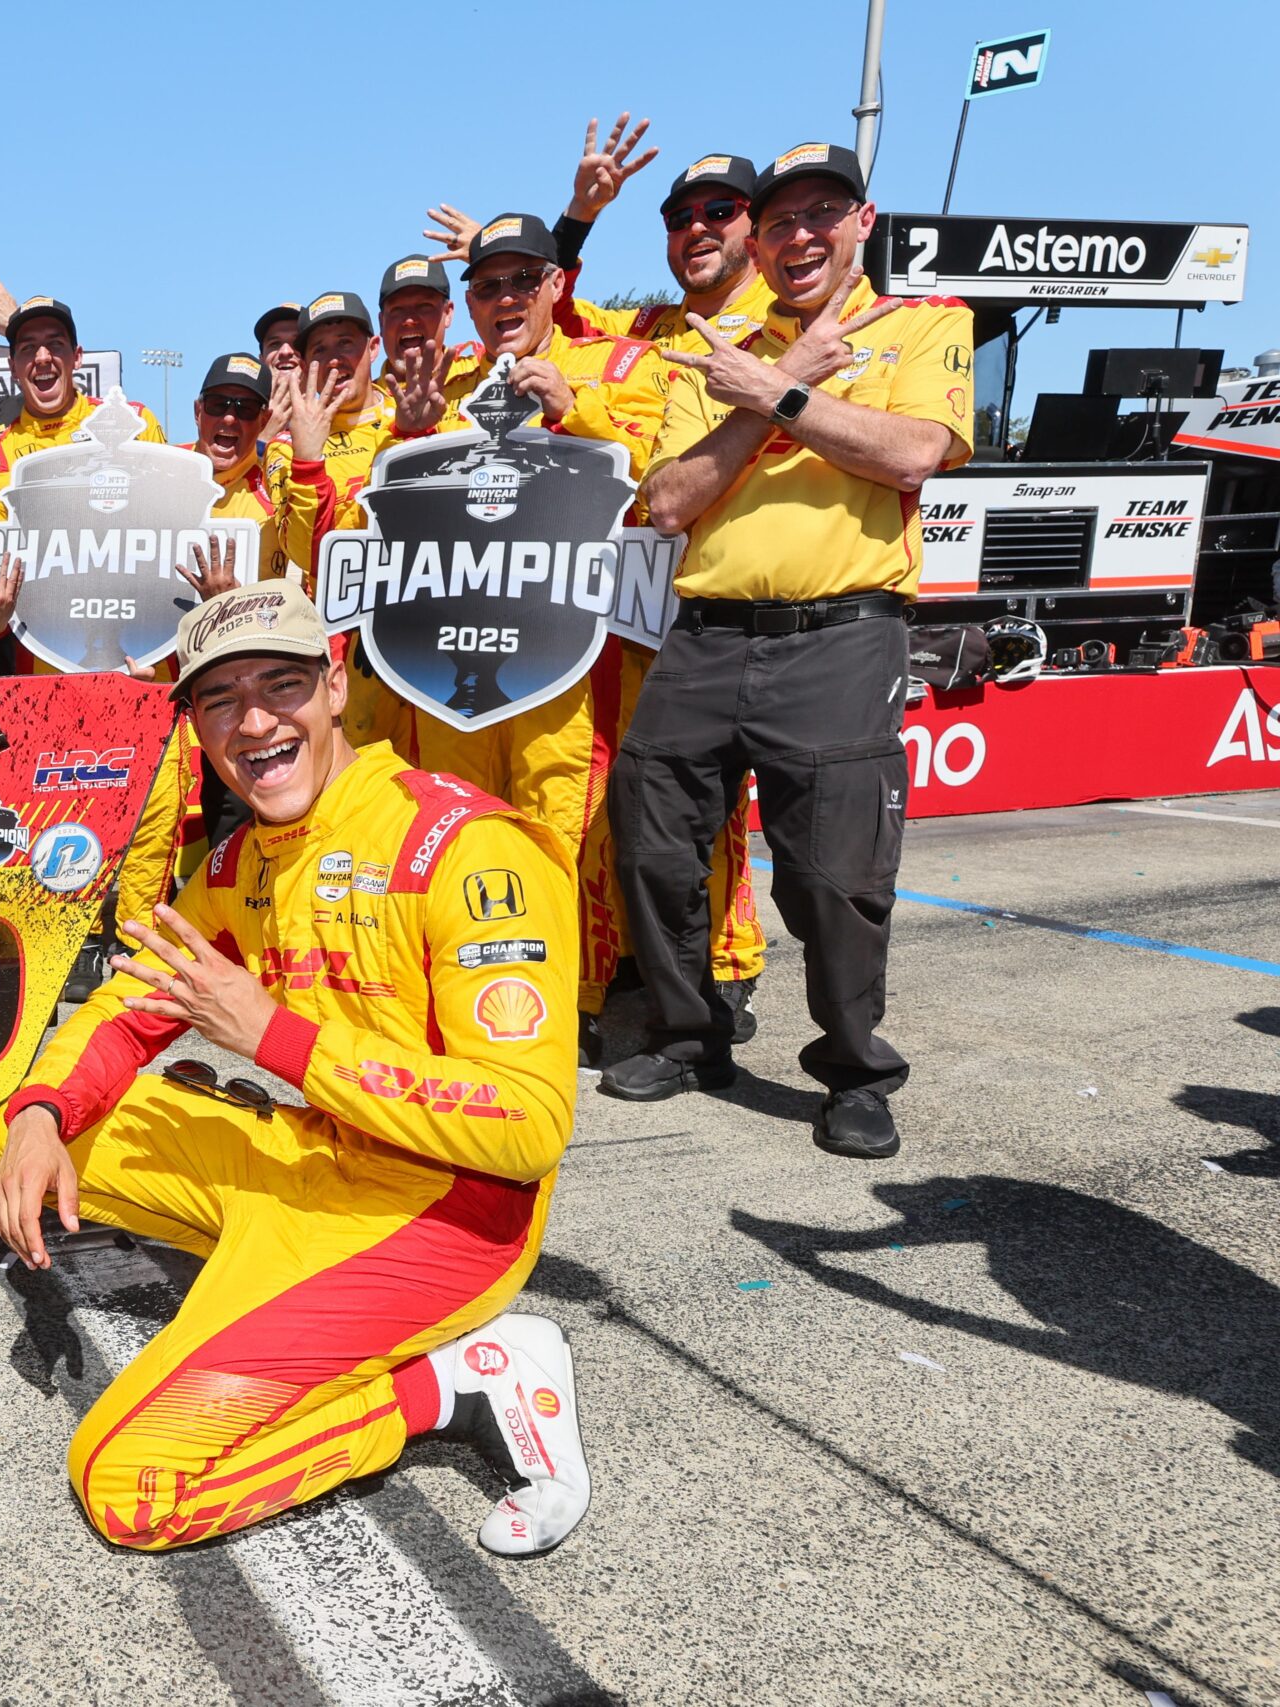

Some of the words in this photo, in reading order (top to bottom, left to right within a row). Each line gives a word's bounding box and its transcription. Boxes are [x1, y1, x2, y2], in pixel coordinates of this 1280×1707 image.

[974, 54, 986, 82] TEAM
[979, 50, 994, 88] PENSKE
[990, 43, 1045, 81] 2
[907, 227, 939, 287] 2
[978, 224, 1147, 274] Astemo
[1186, 272, 1237, 281] CHEVROLET
[1028, 284, 1110, 297] NEWGARDEN
[1241, 379, 1280, 403] TE
[1207, 402, 1280, 431] PEN
[322, 446, 370, 459] HONDA
[108, 475, 128, 485] NTT
[491, 474, 516, 484] NTT
[89, 487, 129, 496] INDYCAR
[467, 488, 518, 499] INDYCAR
[1012, 484, 1077, 500] Snap-on
[920, 503, 969, 521] EAM
[1126, 500, 1189, 516] TEAM
[923, 526, 973, 542] SKE
[1104, 521, 1192, 539] PENSKE
[324, 538, 675, 639] CHAMPION
[69, 598, 136, 620] 2025
[217, 614, 254, 638] 2025
[437, 626, 520, 653] 2025
[33, 746, 136, 786] HRC
[79, 779, 128, 789] RACING
[409, 805, 472, 878] sparco
[336, 858, 352, 868] NTT
[317, 871, 352, 882] INDYCAR
[335, 912, 348, 925] A.
[482, 942, 544, 954] CHAMPION
[358, 1059, 509, 1119] DHL
[535, 1392, 559, 1415] 10
[504, 1407, 537, 1467] sparco
